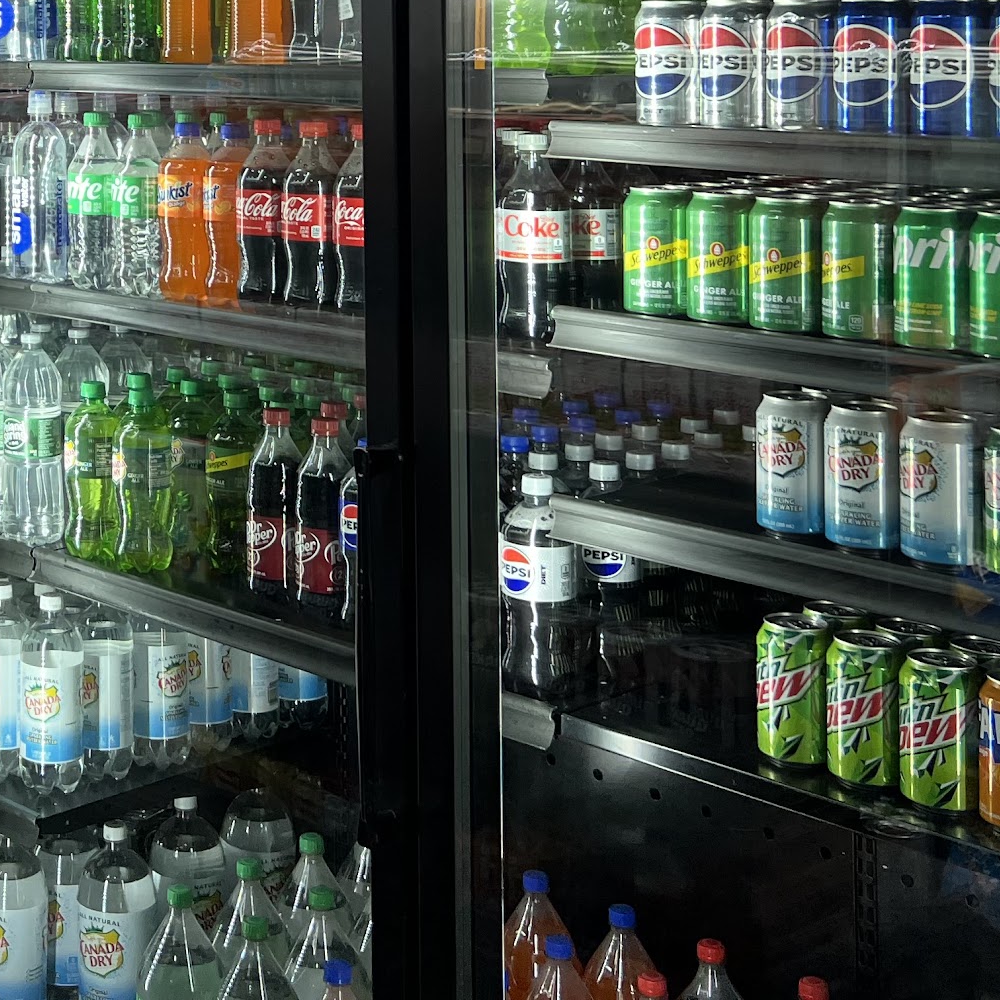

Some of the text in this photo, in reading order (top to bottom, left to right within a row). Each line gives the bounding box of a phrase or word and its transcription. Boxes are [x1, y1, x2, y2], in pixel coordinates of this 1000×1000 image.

[701, 54, 748, 71] EPSI
[834, 56, 896, 74] PEPSI
[11, 176, 22, 245] smart
[504, 214, 560, 238] Coke
[631, 244, 687, 268] Scweppes
[630, 278, 664, 289] GIGER
[693, 285, 727, 296] GNGER
[785, 295, 803, 304] ALE
[759, 441, 807, 457] CANADA
[769, 452, 794, 468] DRY
[828, 453, 884, 469] CANADA
[841, 466, 870, 482] DRY
[584, 548, 624, 562] PEPSI
[501, 562, 531, 579] PEPSI
[25, 695, 62, 710] CANADA
[88, 914, 121, 928] NATURAL
[79, 939, 125, 958] CANADA
[90, 954, 115, 968] DRY
